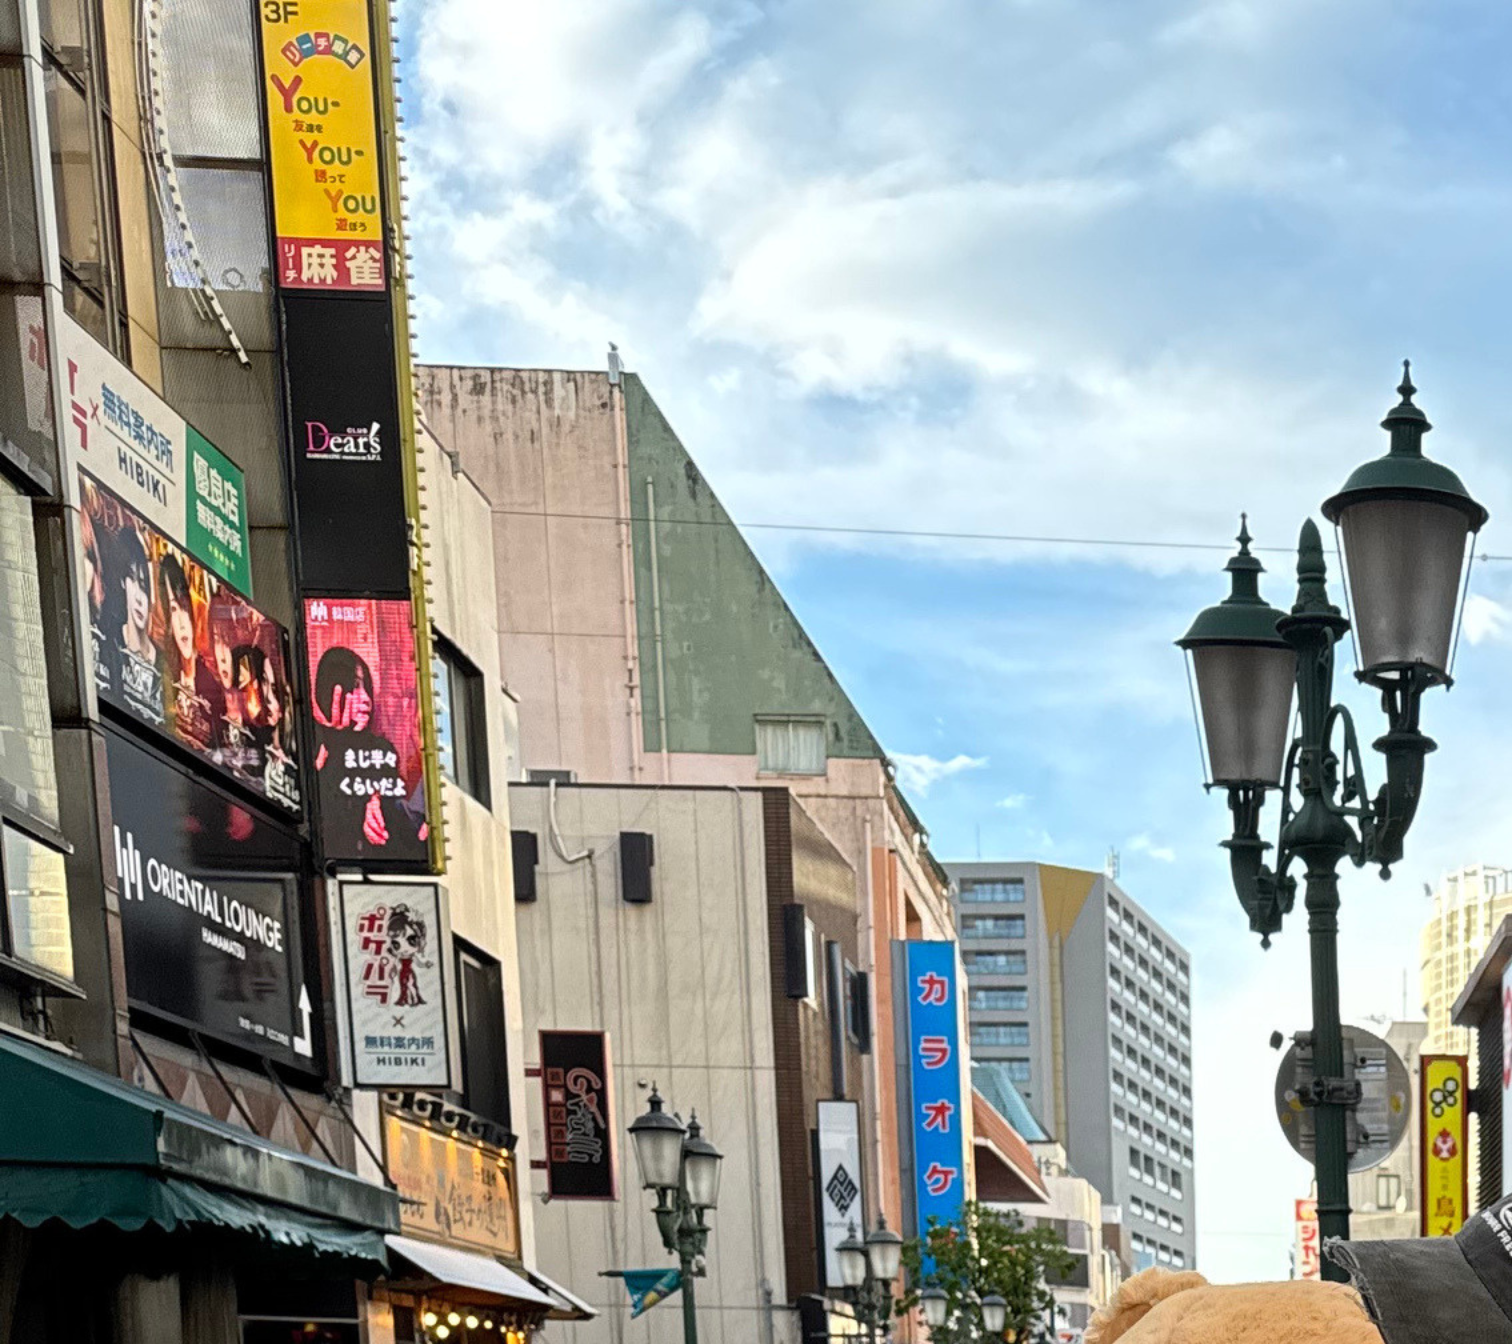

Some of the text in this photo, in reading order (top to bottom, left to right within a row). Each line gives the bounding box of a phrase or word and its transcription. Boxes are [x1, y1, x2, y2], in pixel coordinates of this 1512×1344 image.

[264, 1, 298, 23] 3F
[324, 188, 376, 214] YOU
[284, 243, 298, 282] リーチ
[301, 244, 382, 285] 麻雀
[102, 382, 173, 473] 無料案内所
[117, 446, 167, 507] HIBIKI
[339, 776, 407, 797] くらいだよ
[147, 858, 283, 953] ORIENTAL LOUNGE
[358, 906, 389, 1005] ポケパラ
[364, 1035, 434, 1050] 無料案内所
[376, 1056, 426, 1067] HIBIKI
[918, 972, 957, 1195] カラオケ
